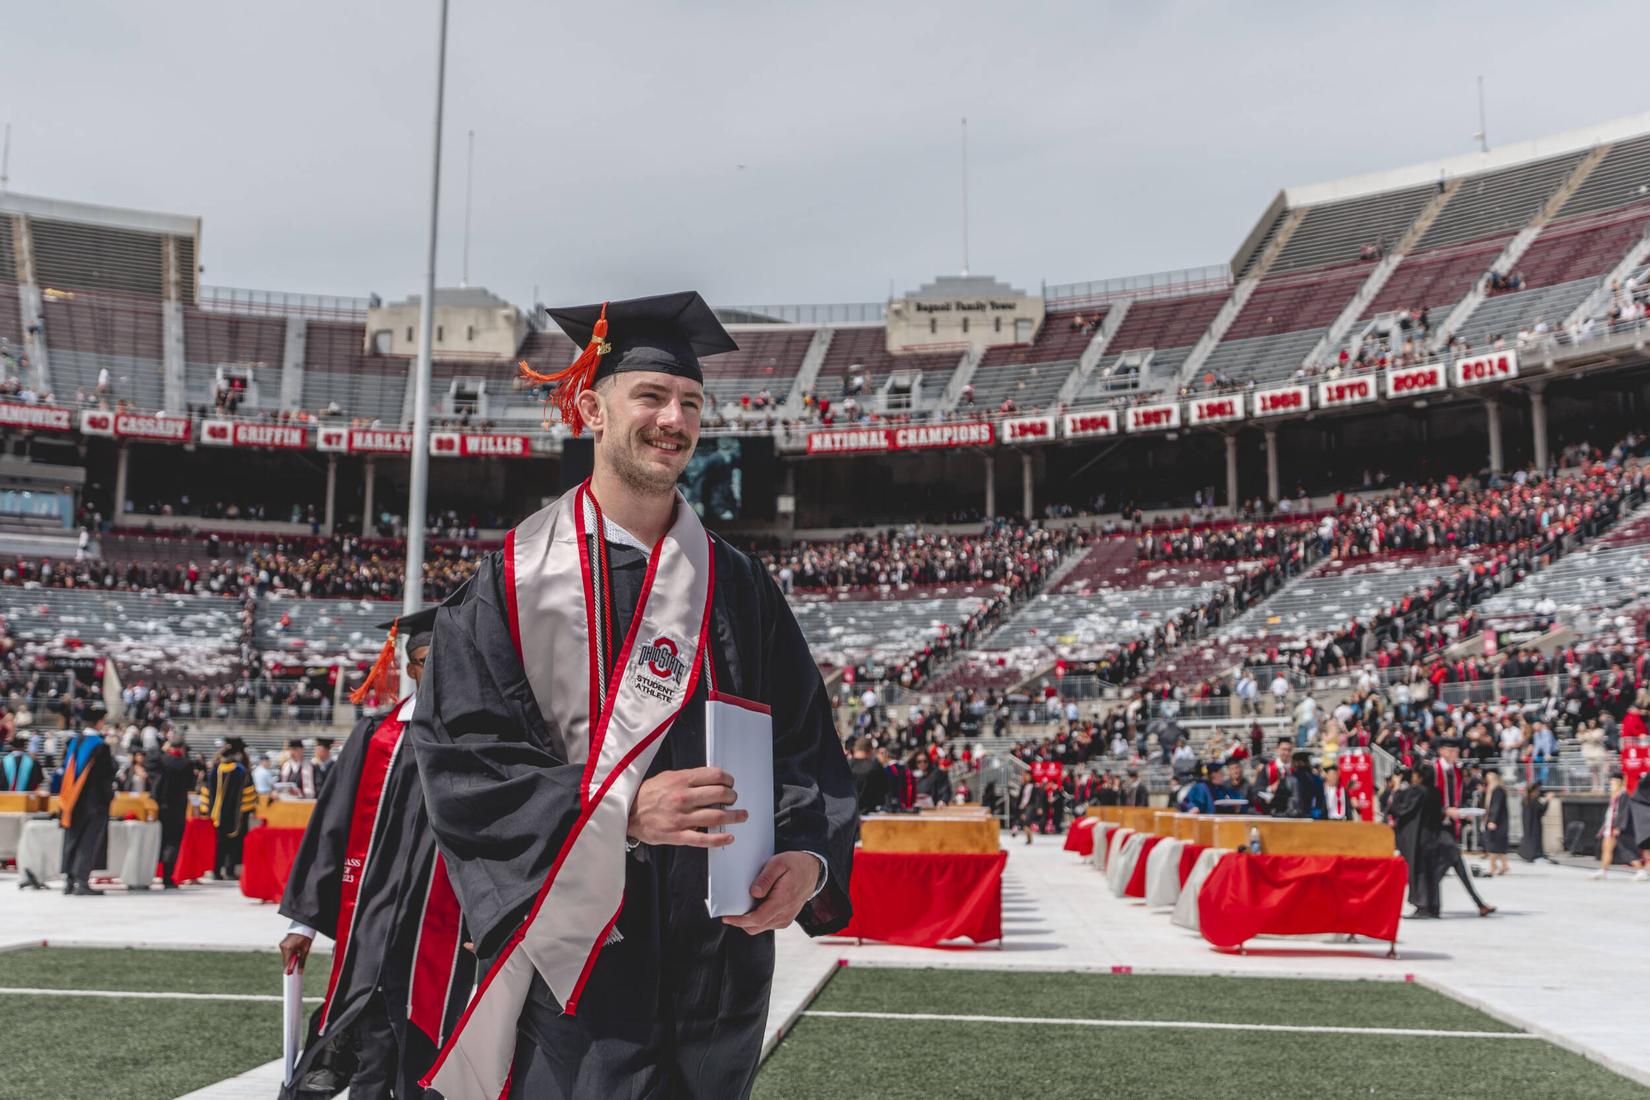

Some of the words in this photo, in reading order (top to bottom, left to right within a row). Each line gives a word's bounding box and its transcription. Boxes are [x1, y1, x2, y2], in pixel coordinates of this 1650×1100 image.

[956, 301, 986, 312] Family
[1462, 357, 1508, 380] 2014
[1327, 381, 1368, 402] 1970
[1197, 400, 1235, 420] 1961
[87, 416, 109, 430] 40
[118, 415, 185, 438] CASSADY
[237, 425, 301, 446] GRIFFIN
[812, 430, 888, 450] NATIONAL
[896, 423, 990, 446] CHAMPIONS
[1010, 421, 1047, 438] 1942
[323, 432, 342, 446] 47
[353, 432, 412, 451] HARLEY
[466, 435, 523, 453] WILLIS
[638, 645, 661, 666] OHIO
[658, 647, 685, 687] STATE
[635, 682, 673, 704] ATHLETE
[636, 674, 674, 696] STUDENT
[344, 858, 361, 868] ASS
